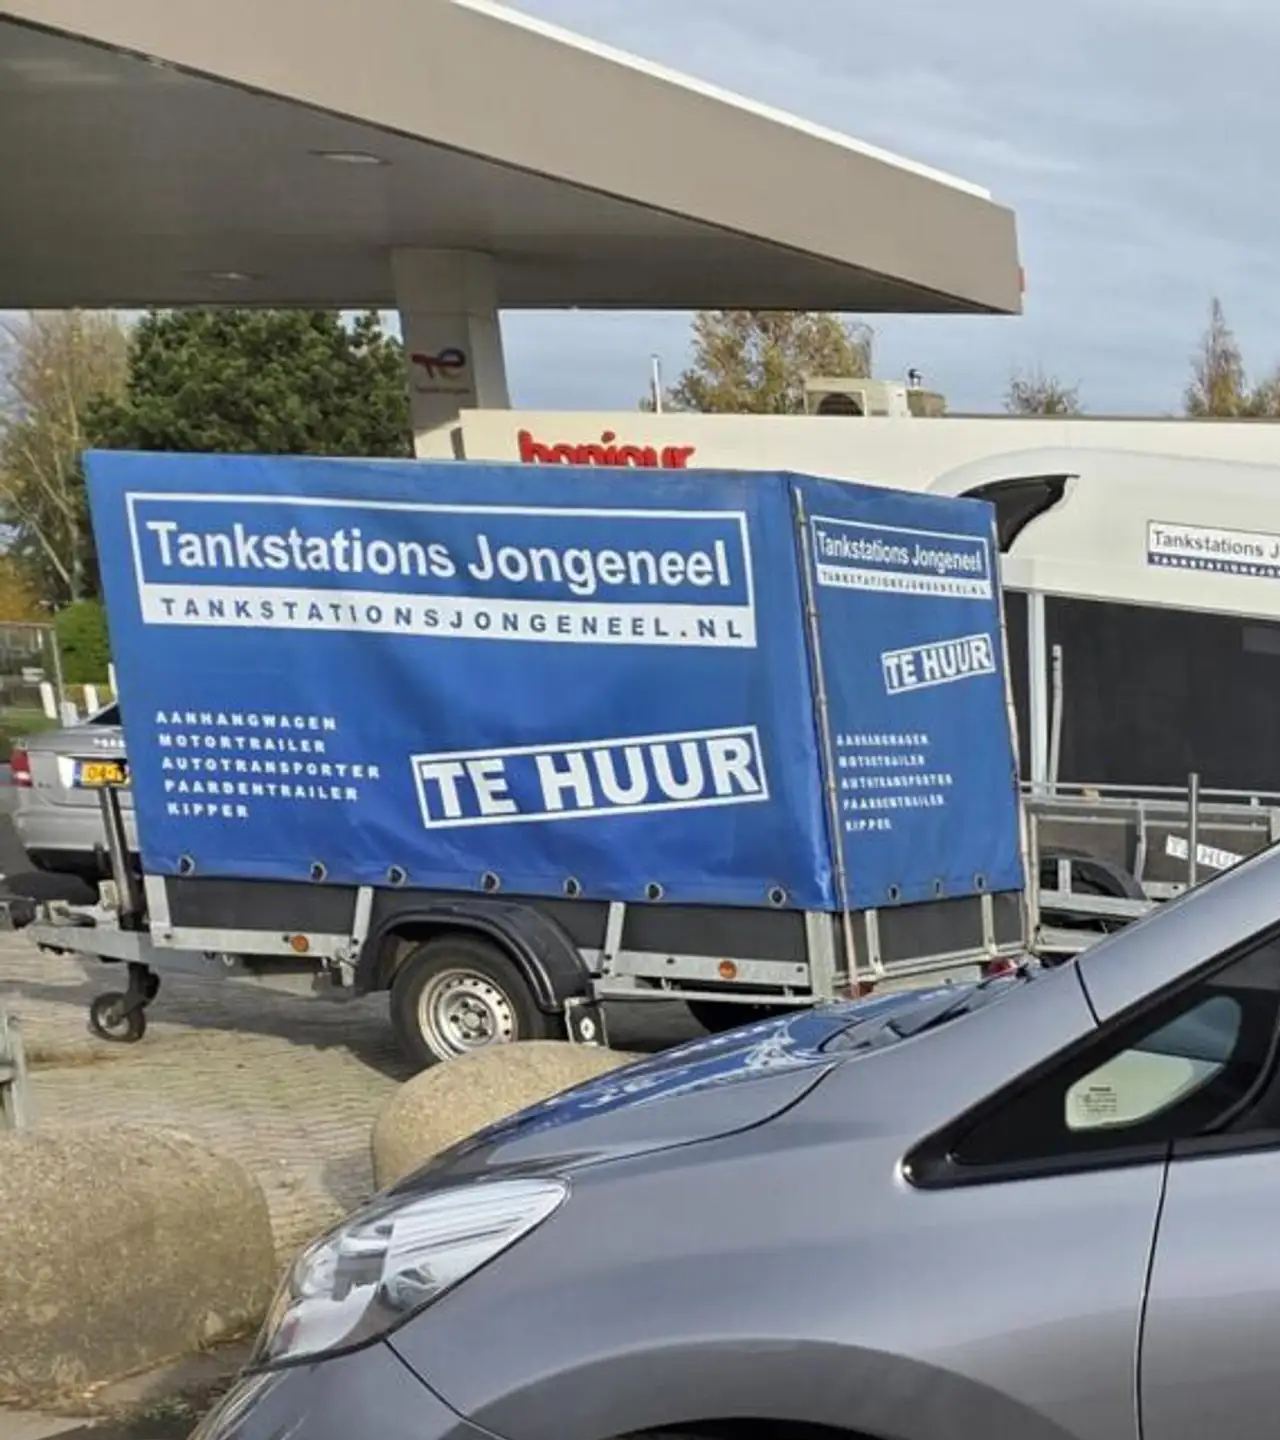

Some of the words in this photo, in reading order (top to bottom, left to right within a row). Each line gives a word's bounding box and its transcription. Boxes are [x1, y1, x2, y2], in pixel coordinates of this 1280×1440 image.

[145, 520, 456, 577] Tankstations
[468, 534, 731, 595] Jongeneel
[816, 530, 910, 566] Tankstations
[912, 544, 983, 575] Jongeneel
[1153, 530, 1264, 558] Tankstations
[160, 598, 743, 638] TANKSTATIONSJONGENEEL.NL
[884, 653, 917, 690] TE
[920, 638, 991, 681] HUUR
[155, 710, 338, 731] AANHANGWAGEN
[157, 732, 326, 753] MOTORTRAILER
[161, 756, 381, 780] AUTOTRANSPORTER
[422, 758, 519, 818] TE
[535, 737, 763, 812] HUUR
[163, 779, 359, 801] PAARDENTRAILER
[166, 802, 248, 818] KIPPER
